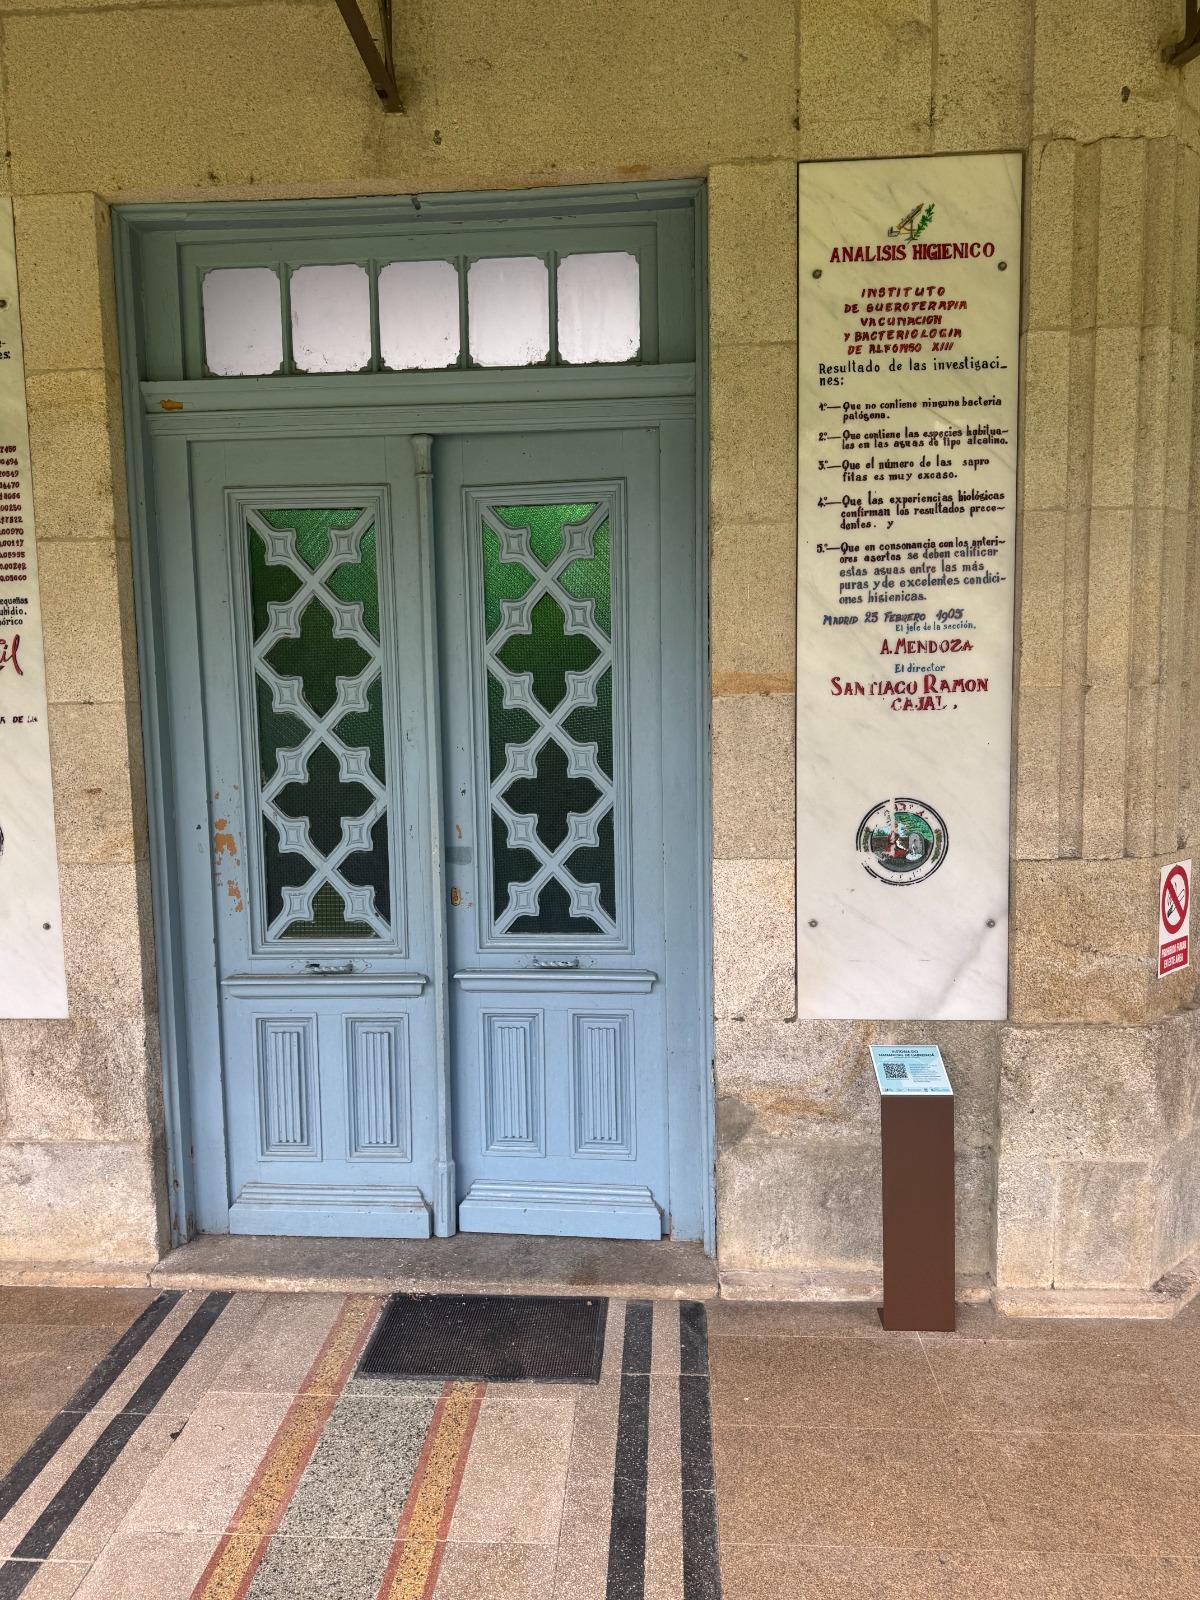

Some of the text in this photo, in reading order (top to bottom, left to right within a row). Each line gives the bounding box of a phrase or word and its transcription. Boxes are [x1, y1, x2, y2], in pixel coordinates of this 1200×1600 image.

[829, 242, 996, 263] ANALISIS HIGIENICO
[861, 286, 946, 298] INSTITUTO
[844, 303, 860, 313] DE
[860, 315, 943, 327] VACUNACION
[844, 328, 963, 342] Y BACTERIOLOGIA
[848, 341, 954, 355] DE ALFONSO XIII
[819, 359, 881, 375] Resultado
[889, 358, 903, 372] de
[909, 357, 927, 371] las
[819, 376, 844, 386] nes:
[880, 398, 917, 409] contiene
[922, 397, 960, 409] ninguna
[962, 395, 1002, 406] bacteria
[864, 428, 901, 440] contiene
[904, 426, 920, 438] las
[922, 426, 963, 440] especies
[842, 440, 855, 450] les
[874, 437, 889, 448] las
[893, 440, 924, 449] aguas
[929, 436, 939, 447] de
[943, 437, 961, 450] tipo
[967, 434, 1009, 445] alcalino.
[866, 456, 875, 469] el
[878, 458, 915, 471] número
[919, 455, 931, 467] de
[936, 454, 952, 467] las
[962, 457, 990, 471] sapro
[842, 471, 868, 482] fitas
[889, 471, 913, 481] muy
[917, 471, 958, 480] excaso.
[867, 491, 884, 505] las
[889, 492, 954, 509] experiencias
[957, 488, 1005, 502] biológicas
[840, 506, 891, 518] confirman
[896, 504, 910, 516] los
[914, 502, 966, 515] resultados
[886, 520, 894, 529] y
[865, 543, 876, 551] en
[879, 538, 936, 551] consonancia
[939, 541, 954, 549] con
[955, 537, 969, 548] los
[839, 545, 999, 564] ores asertos se deben calificar
[839, 559, 985, 578] estas aguas entre las más
[839, 580, 869, 595] puras
[899, 574, 960, 588] excelentes
[839, 591, 927, 605] ones higienicas.
[823, 614, 859, 626] MADRID
[883, 610, 926, 623] FEBRERO
[895, 624, 905, 632] El
[906, 622, 921, 634] jefe
[924, 622, 931, 631] de
[933, 621, 941, 631] la
[894, 662, 946, 673] El director
[923, 674, 989, 694] RAMON
